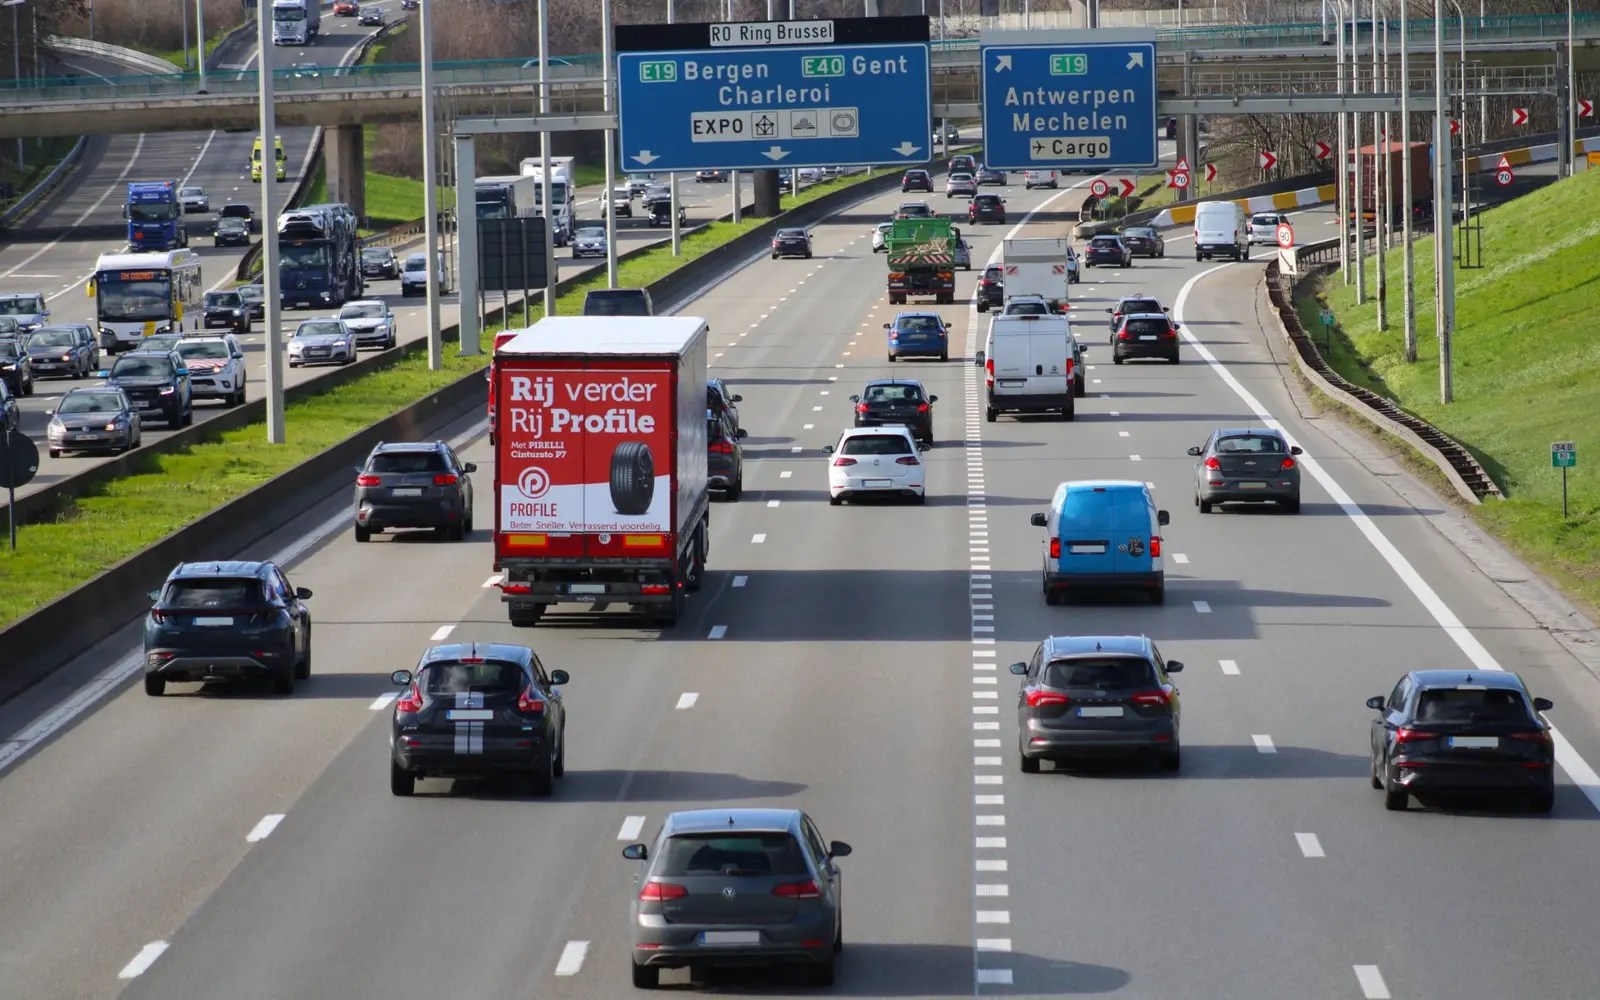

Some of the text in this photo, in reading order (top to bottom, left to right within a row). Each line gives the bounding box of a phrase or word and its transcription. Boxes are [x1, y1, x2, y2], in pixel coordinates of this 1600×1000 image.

[740, 25, 771, 44] Ring
[777, 23, 832, 40] Brussel
[642, 62, 769, 84] E19 Bergen
[804, 55, 907, 75] E40 Gent
[1053, 56, 1085, 73] E19
[719, 83, 830, 105] Charleroi
[1005, 86, 1136, 108] Antwerpen
[693, 118, 743, 135] EXPO
[1013, 111, 1128, 132] Mechelen
[1052, 139, 1108, 158] Cargo
[1176, 176, 1186, 184] 70
[1500, 173, 1510, 181] 70
[1280, 231, 1290, 242] 90
[510, 376, 657, 407] Rij verder
[510, 408, 655, 439] Rij Profile
[511, 441, 564, 449] Met PIRELLI
[510, 503, 557, 516] PROFILE
